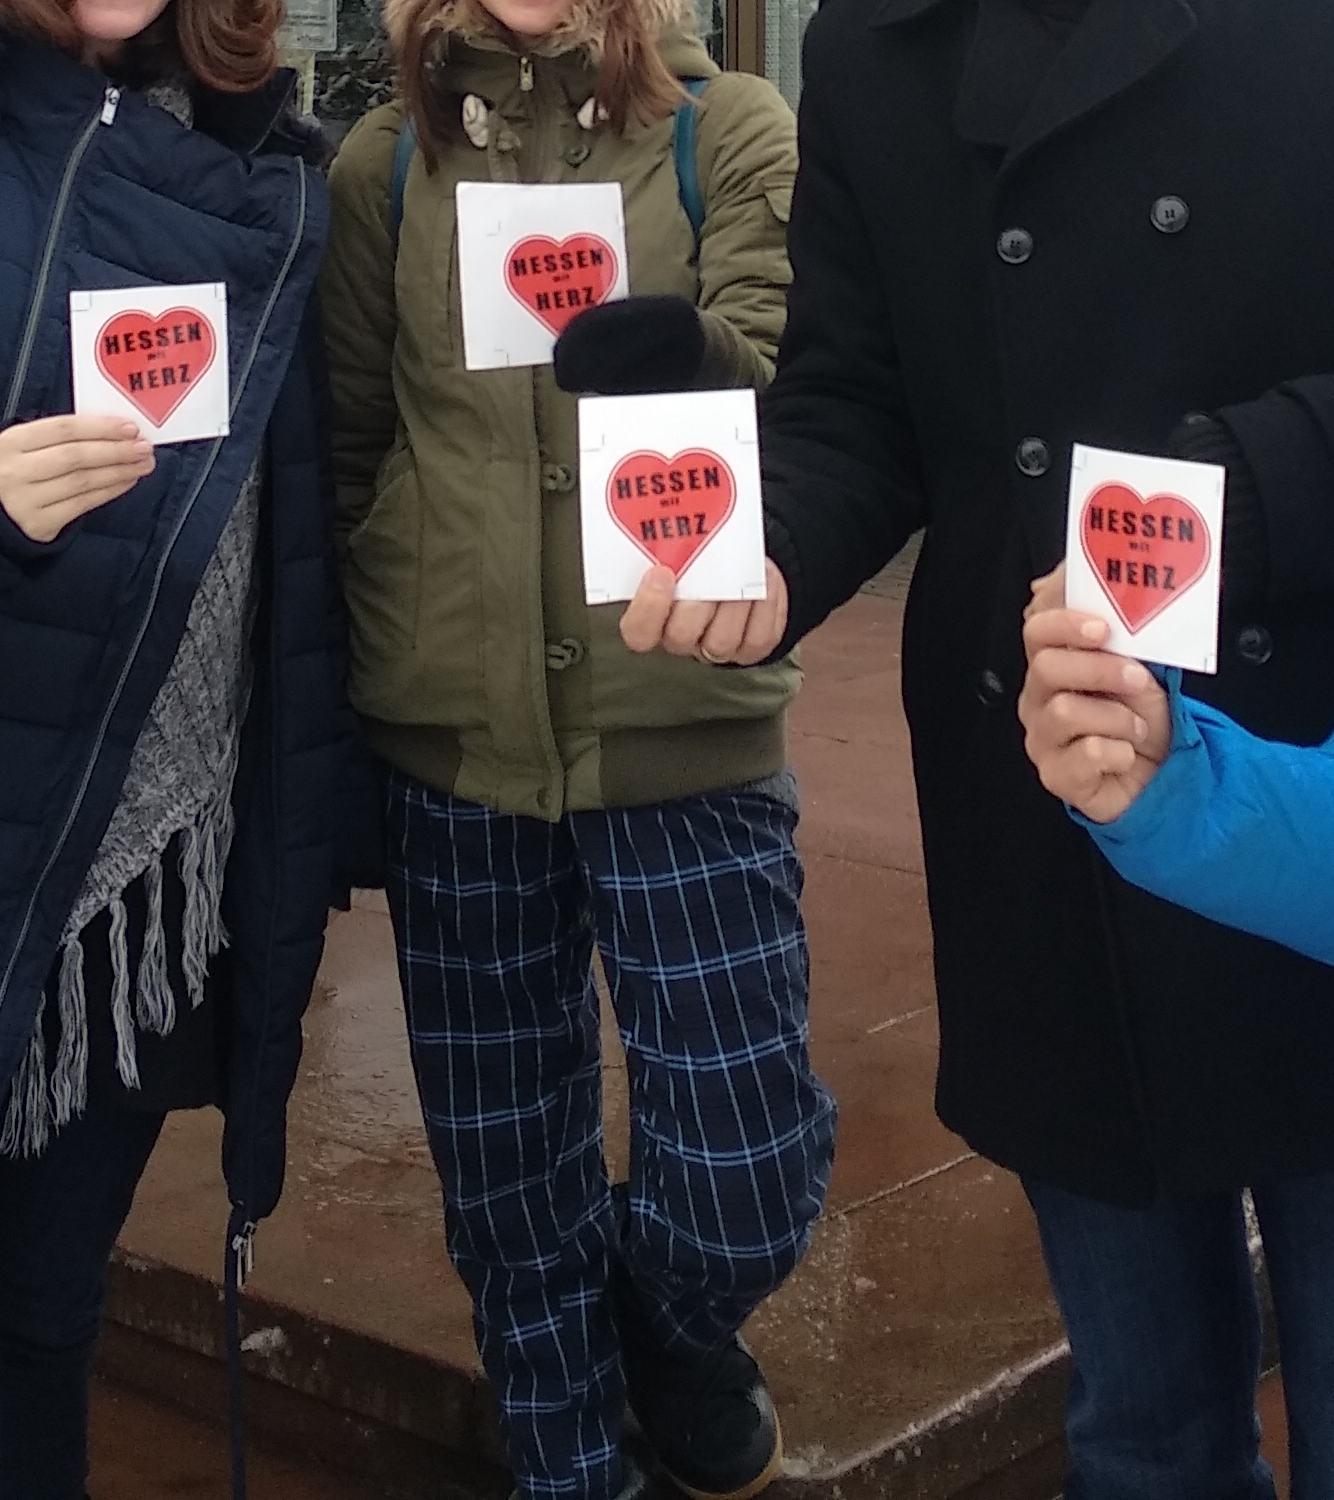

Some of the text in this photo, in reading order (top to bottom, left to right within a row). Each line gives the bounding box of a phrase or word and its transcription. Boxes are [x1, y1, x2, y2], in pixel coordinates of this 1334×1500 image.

[512, 249, 604, 276] HESSEN
[535, 286, 595, 311] HERZ
[104, 322, 202, 356] HESSEN
[128, 364, 190, 392] HERZ
[616, 466, 721, 500] HESSEN
[639, 513, 708, 541] HERZ
[1089, 506, 1194, 543] HESSEN
[1105, 558, 1176, 591] HERZ
